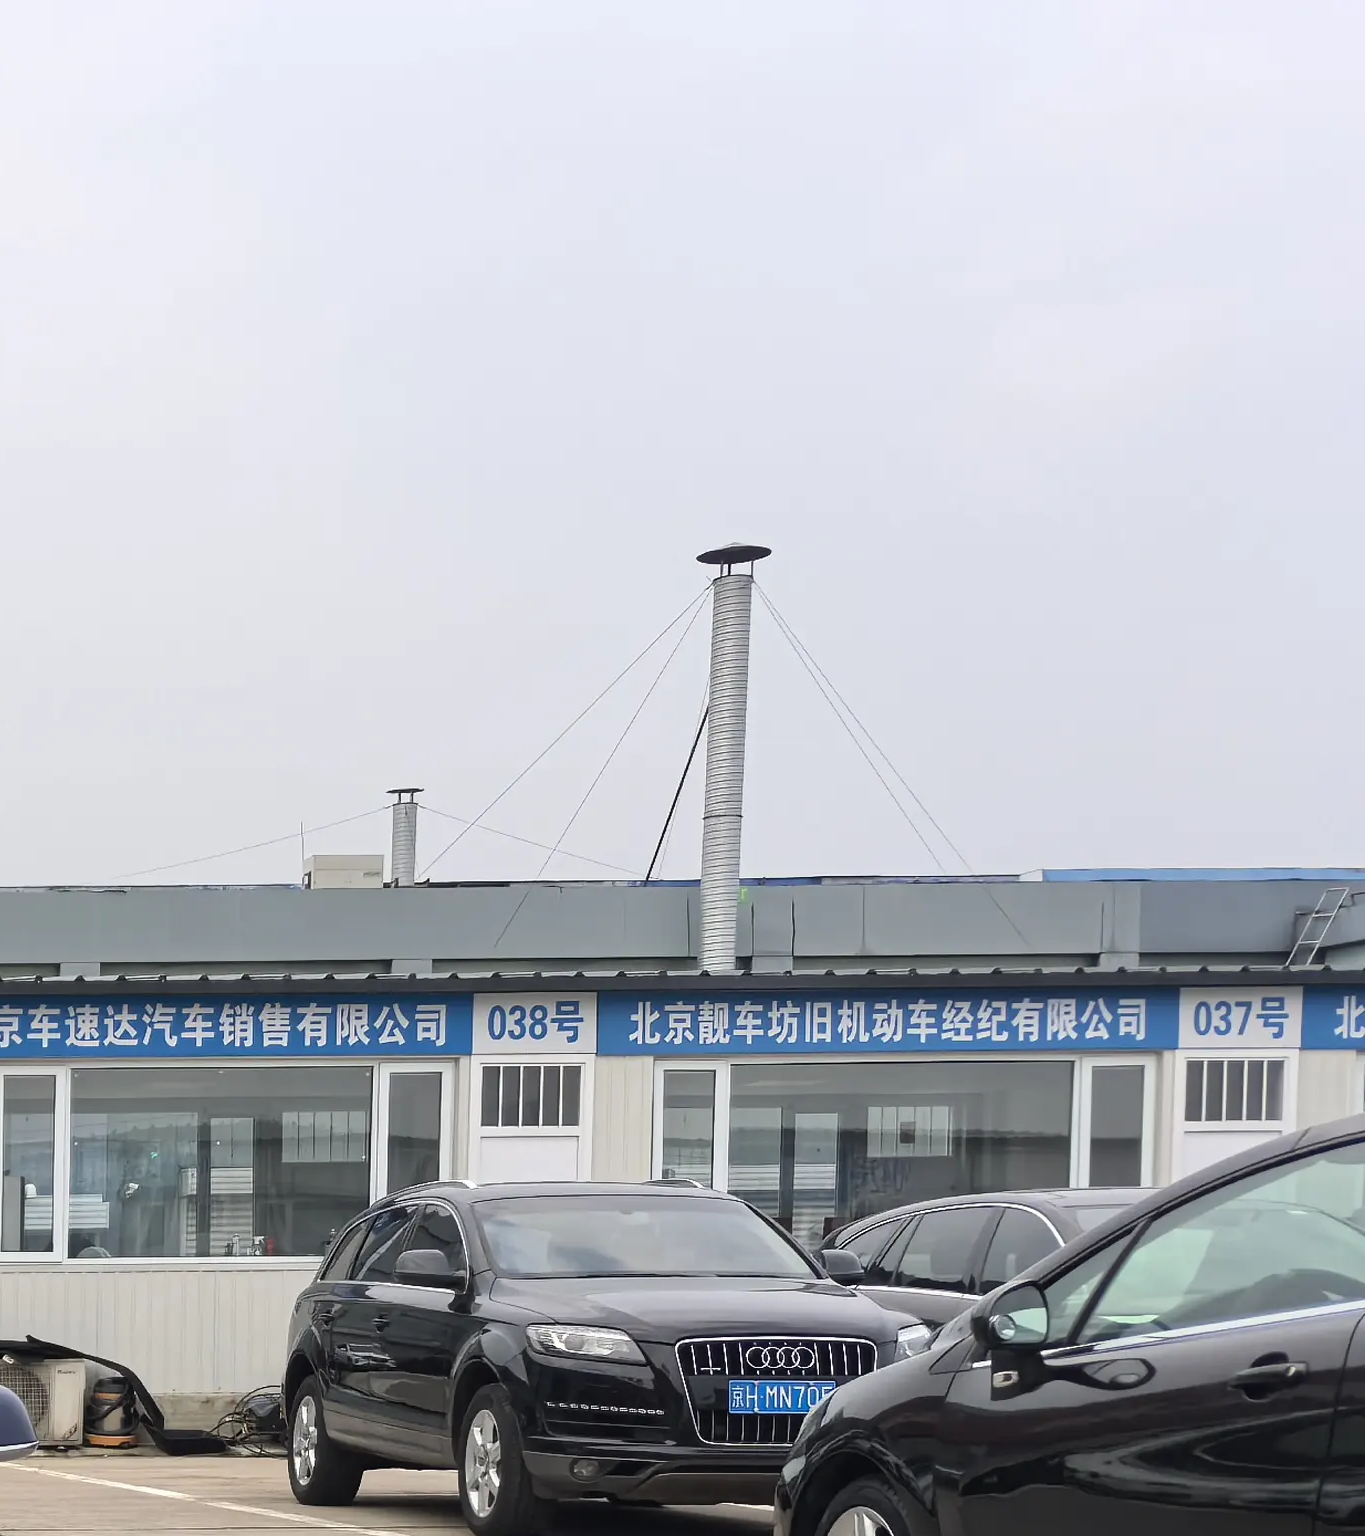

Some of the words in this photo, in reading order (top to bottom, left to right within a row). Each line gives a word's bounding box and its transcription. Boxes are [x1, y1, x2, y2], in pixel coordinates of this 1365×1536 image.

[488, 1000, 584, 1043] 038号
[628, 997, 1148, 1046] 北京靓车坊旧机动车经纪有限公司
[1193, 996, 1289, 1040] 037号
